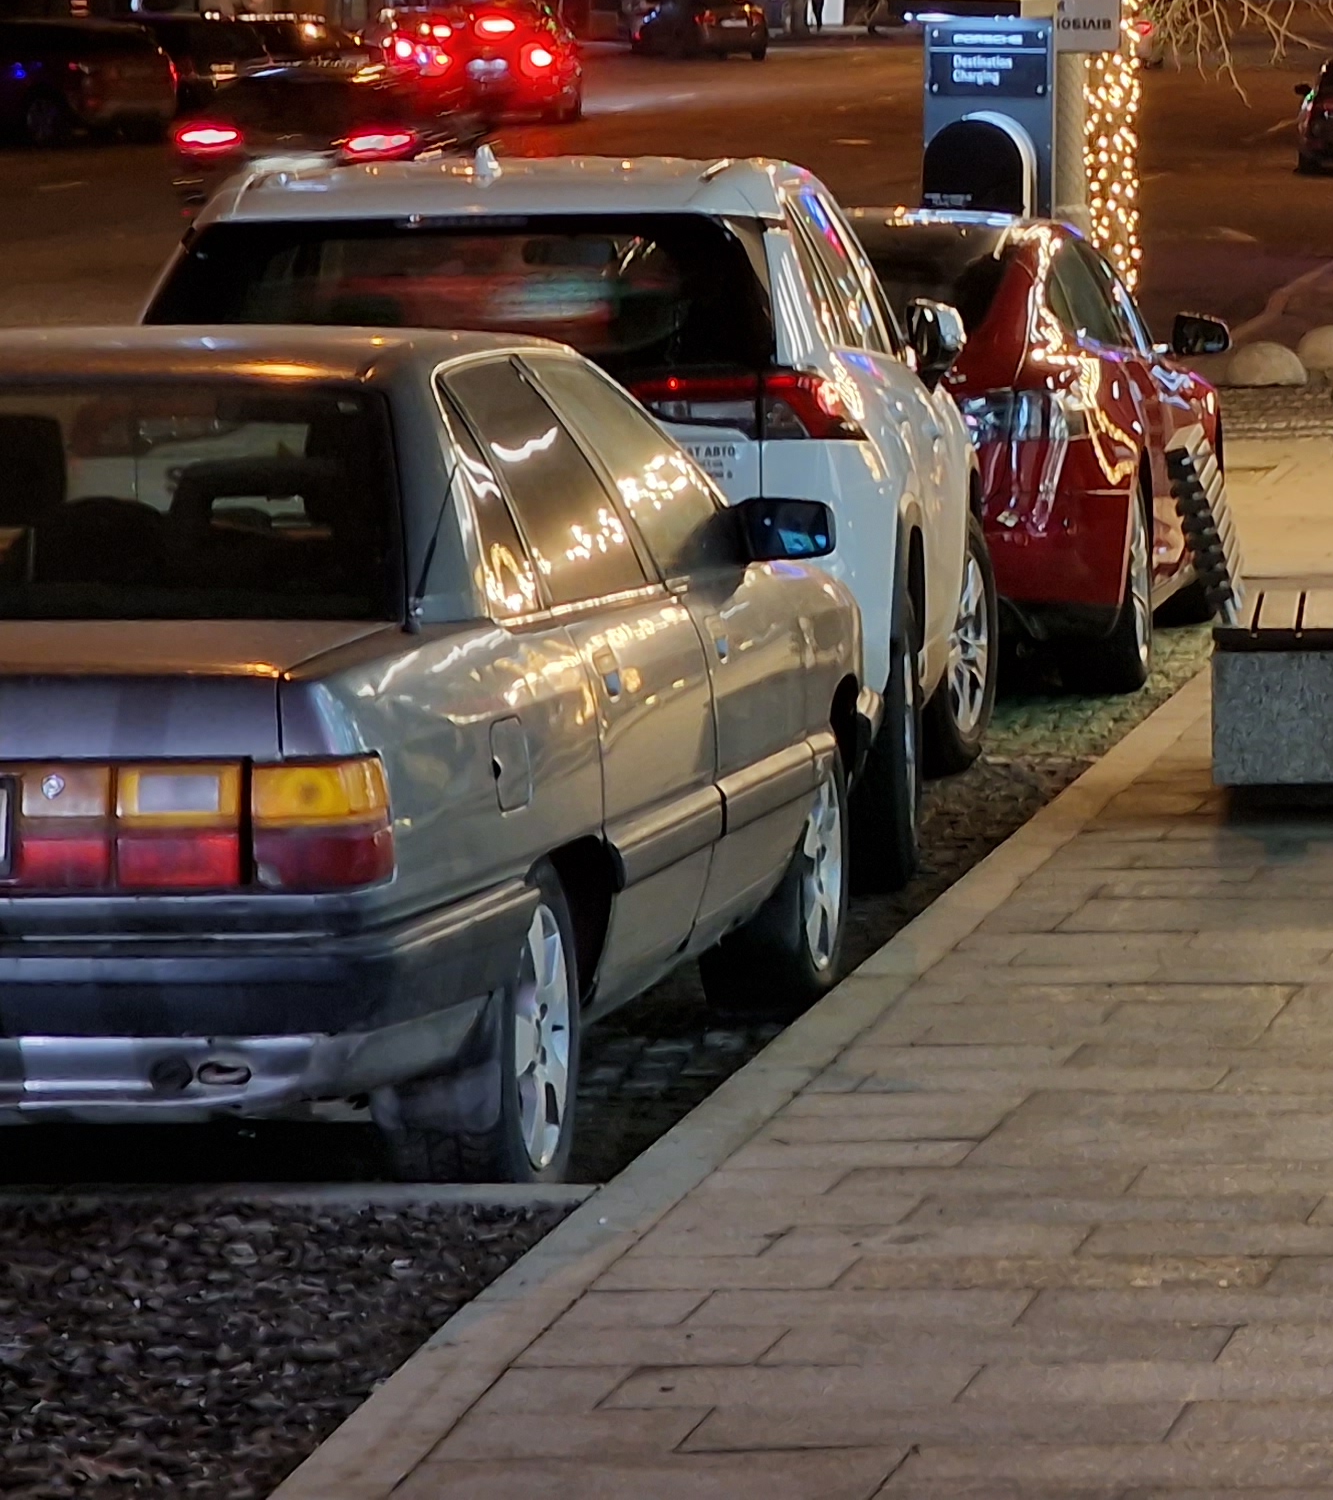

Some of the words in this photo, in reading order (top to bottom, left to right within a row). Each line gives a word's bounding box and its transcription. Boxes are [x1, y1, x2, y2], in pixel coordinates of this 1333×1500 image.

[1056, 17, 1112, 31] ОБІЛІВ
[952, 53, 1014, 70] Destination
[952, 69, 1001, 87] Charging
[704, 445, 736, 458] АВТО
